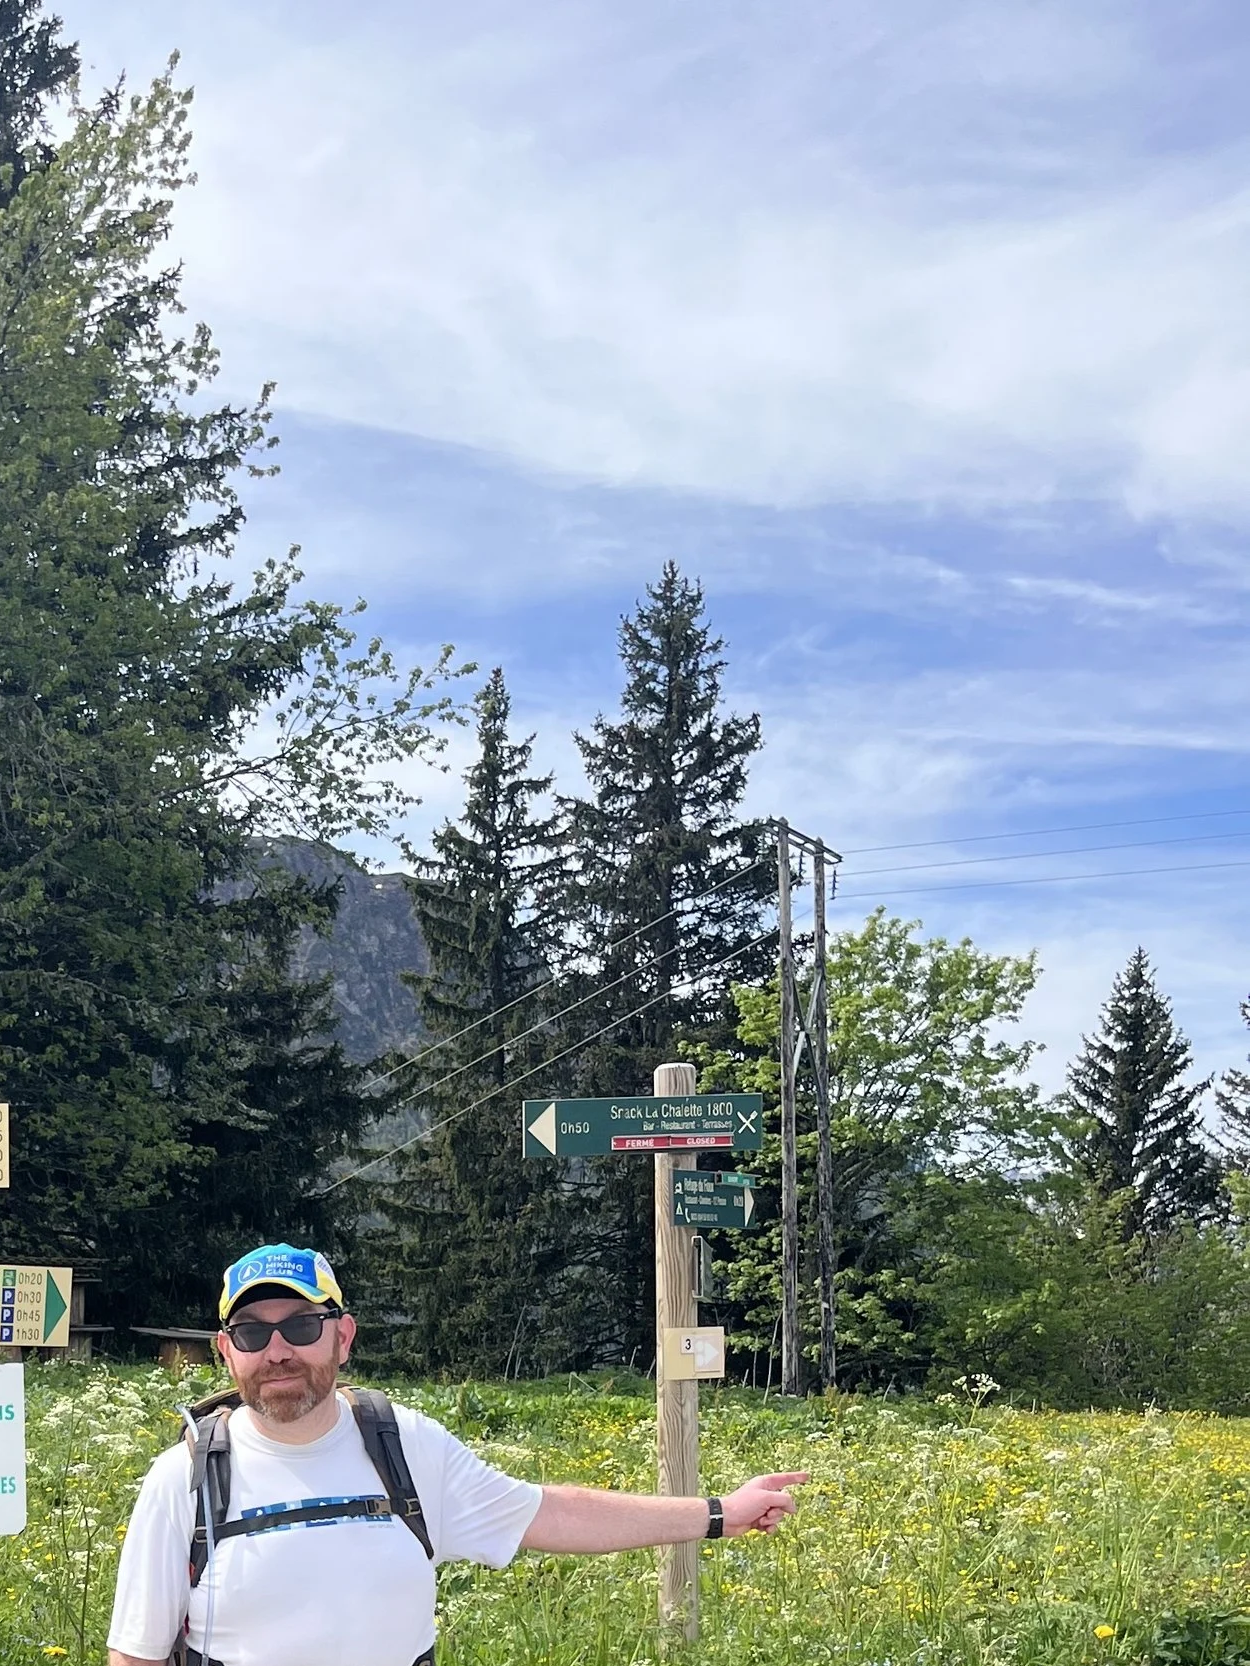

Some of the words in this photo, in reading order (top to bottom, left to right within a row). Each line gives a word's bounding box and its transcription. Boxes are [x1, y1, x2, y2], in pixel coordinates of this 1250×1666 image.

[646, 1105, 659, 1118] La
[707, 1102, 733, 1116] 1800
[560, 1121, 590, 1134] 0h50
[686, 1137, 716, 1145] CLOSED
[265, 1261, 304, 1272] HIKING
[18, 1272, 43, 1285] 0h20
[17, 1291, 42, 1304] 0h30
[16, 1309, 41, 1321] 0h45
[16, 1328, 40, 1341] 1h30
[685, 1338, 692, 1351] 3
